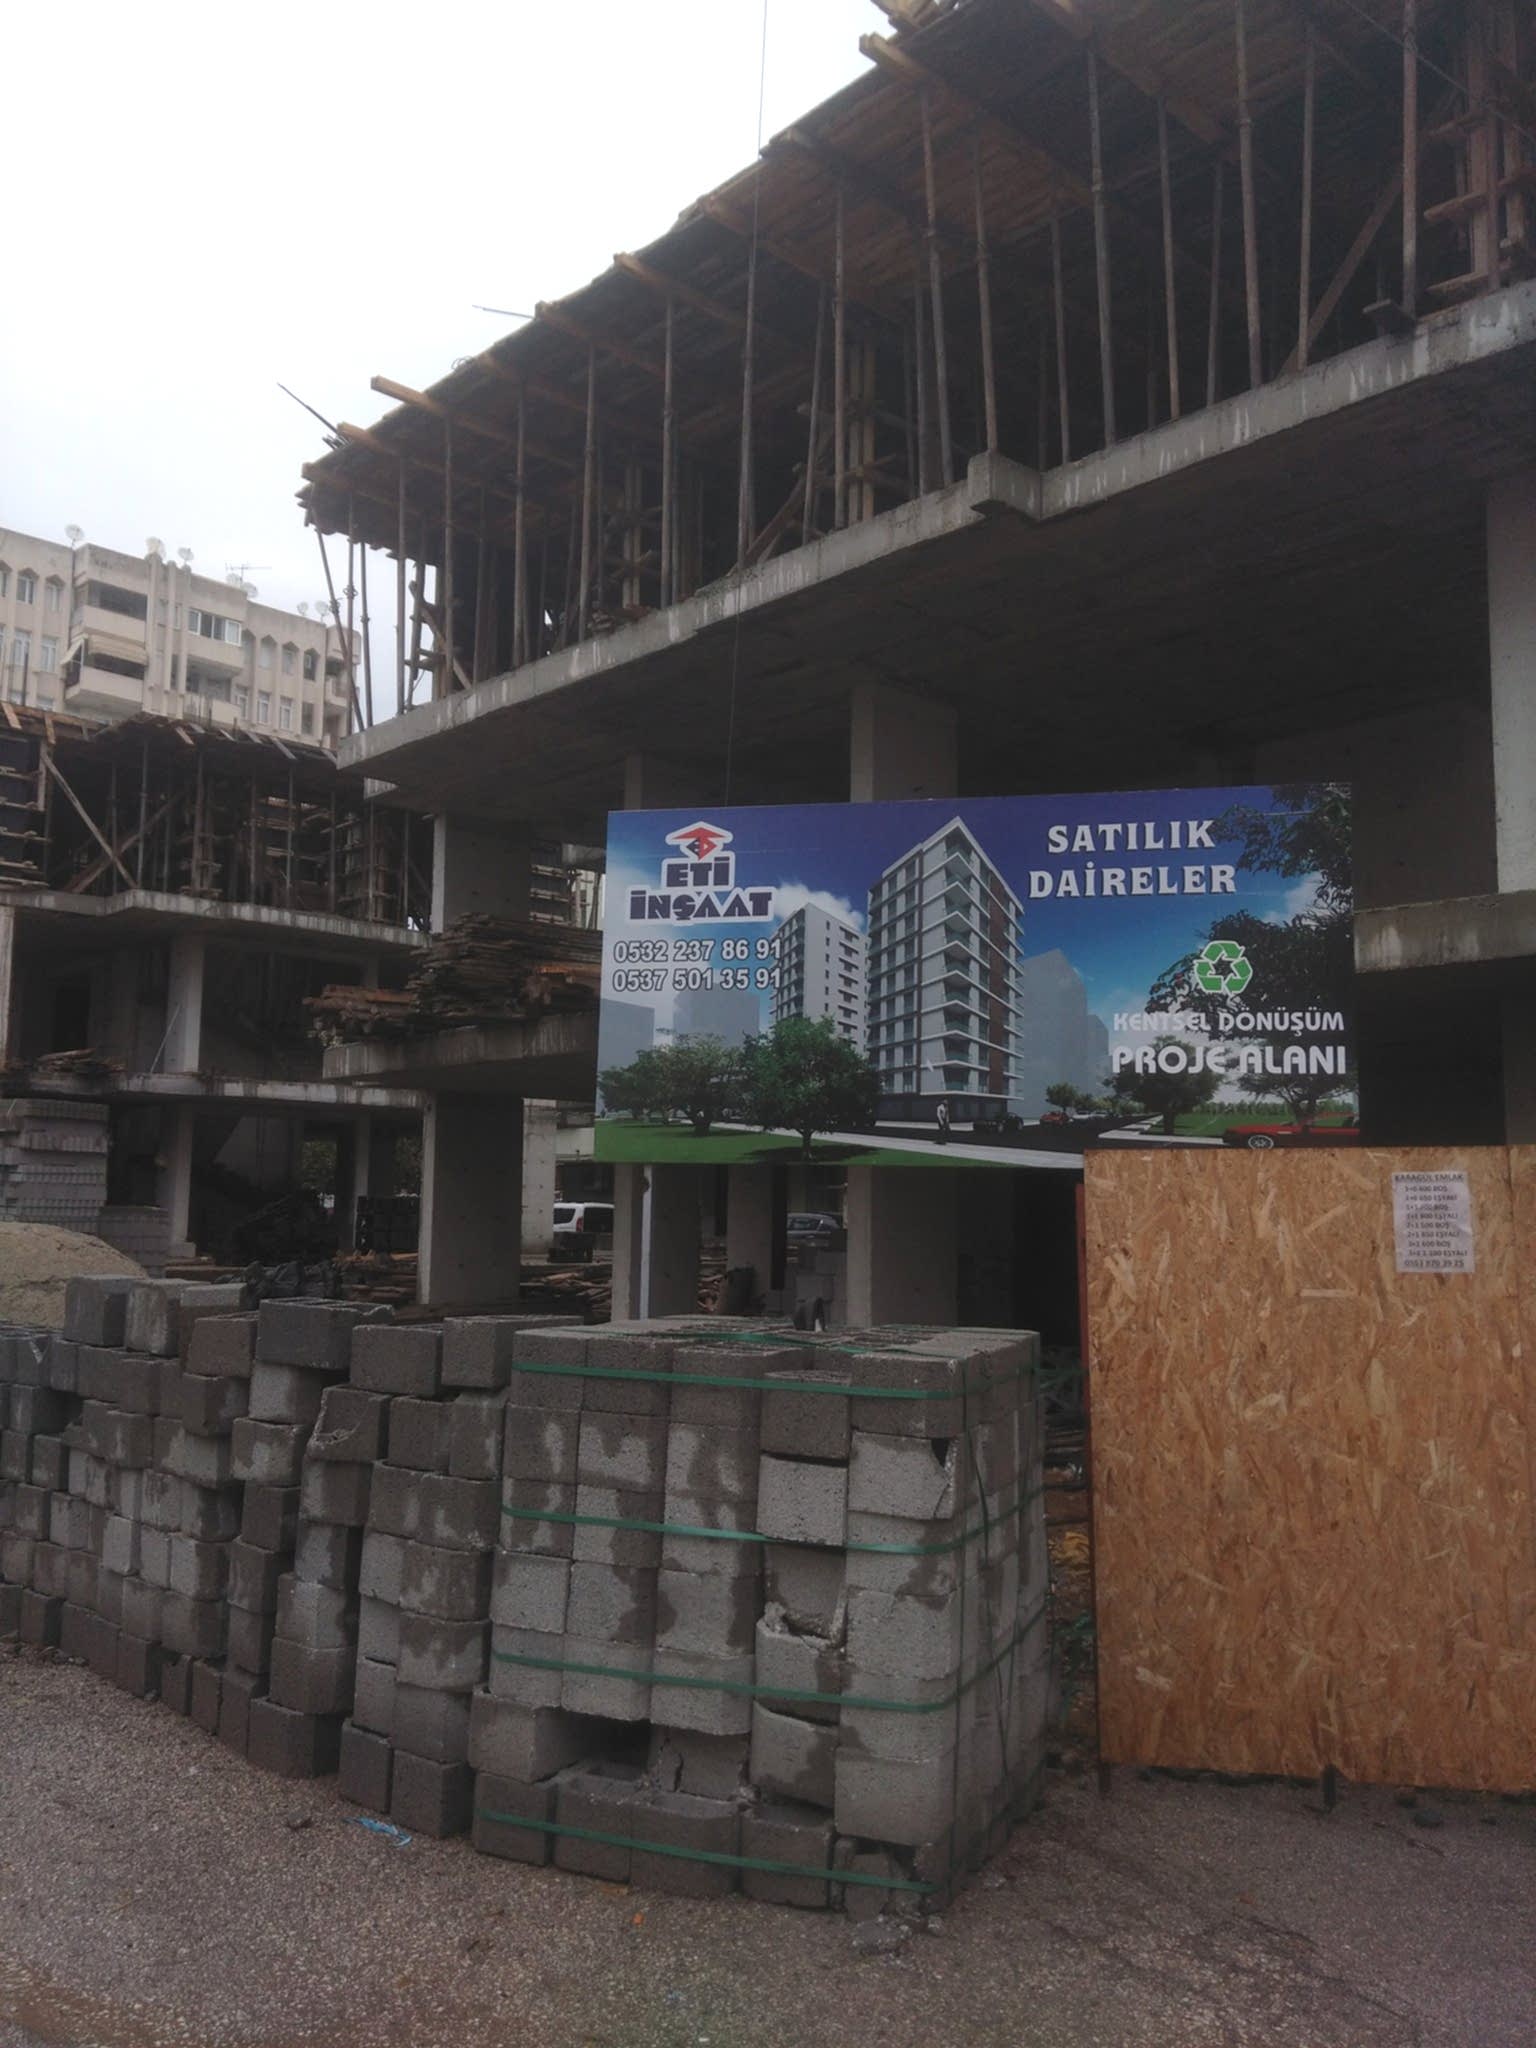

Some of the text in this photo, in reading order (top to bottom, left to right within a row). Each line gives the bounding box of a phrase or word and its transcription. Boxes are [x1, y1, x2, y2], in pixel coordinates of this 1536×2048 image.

[1047, 819, 1216, 854] SATILIK
[666, 856, 730, 888] ETİ
[1028, 861, 1237, 899] DAİRELER
[629, 890, 773, 921] İNŞAAT
[614, 938, 781, 963] 0532 237 86 91
[613, 967, 781, 992] 0537 501 35 91
[1113, 1006, 1345, 1037] KENTSEL DÖNÜŞÜM
[1112, 1045, 1347, 1075] PROJE ALANI
